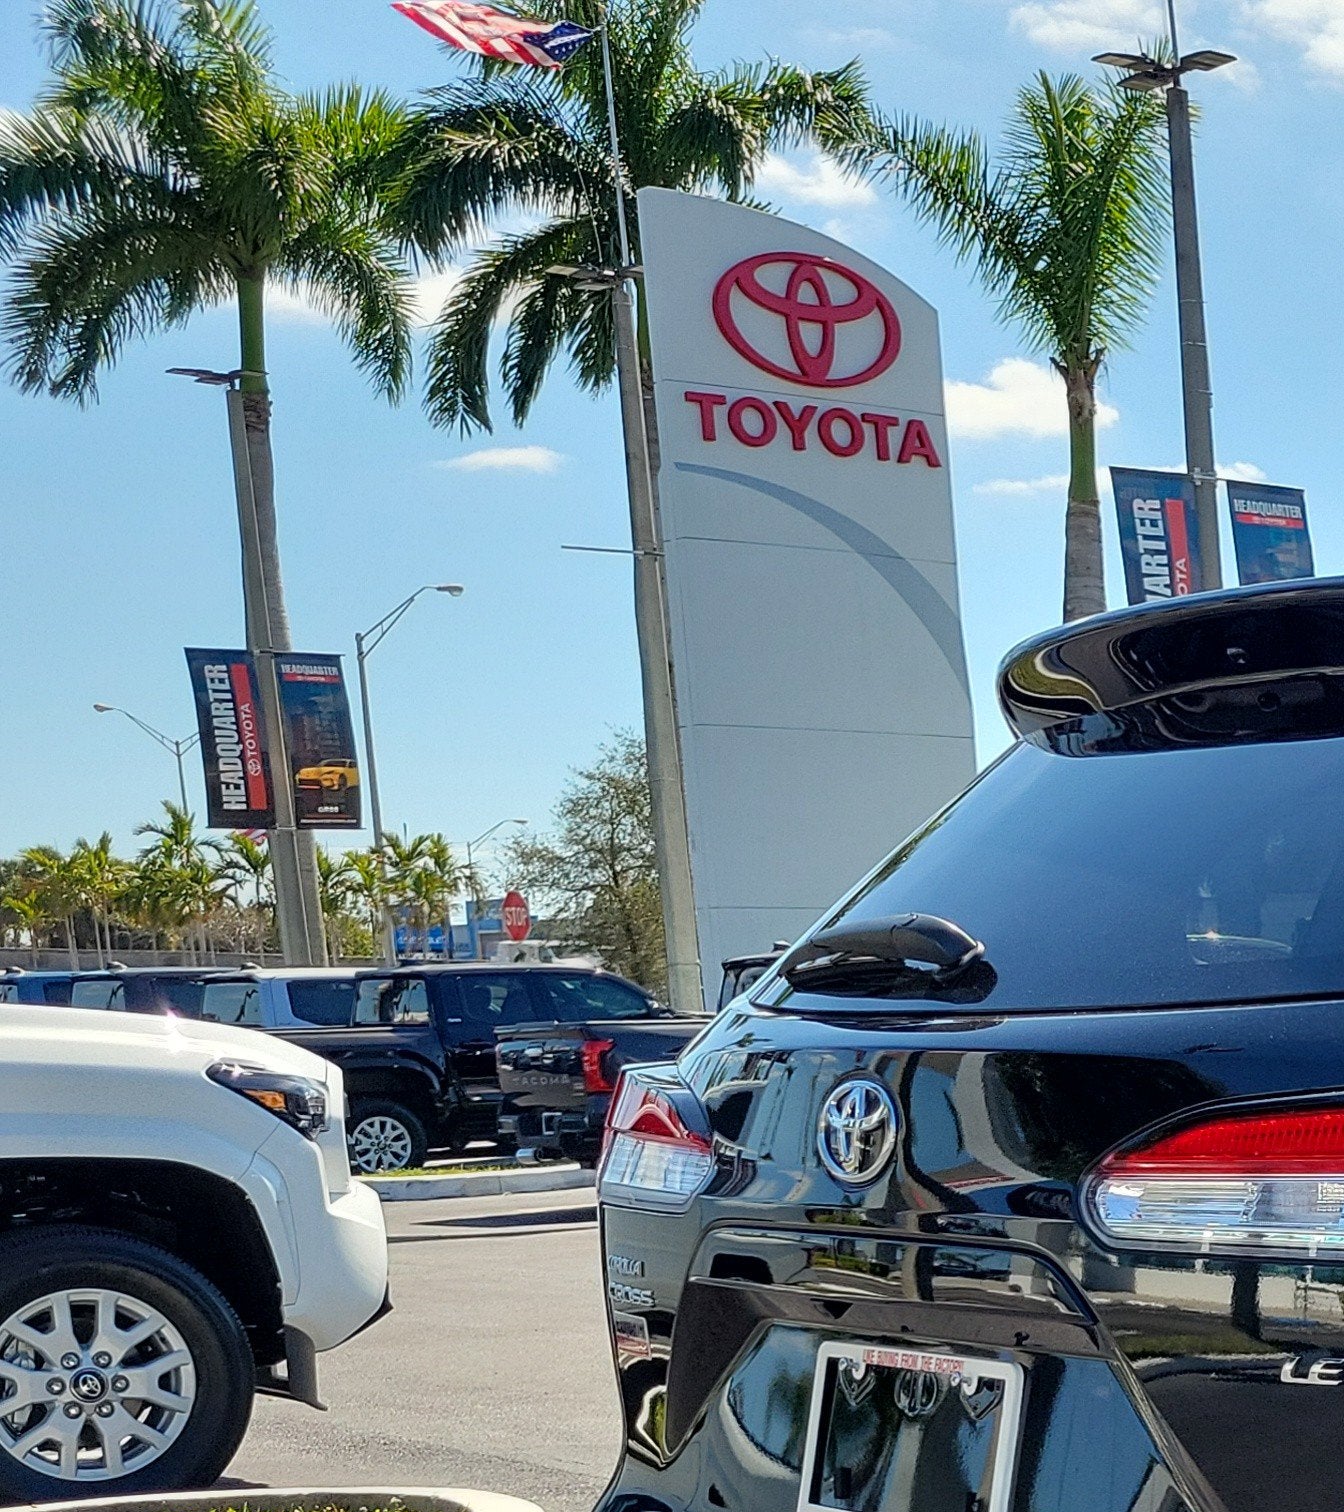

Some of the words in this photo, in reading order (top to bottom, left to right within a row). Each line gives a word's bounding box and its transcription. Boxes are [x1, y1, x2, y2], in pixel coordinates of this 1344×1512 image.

[684, 391, 942, 468] TOYOTA
[1233, 498, 1303, 519] HEADQUARTER
[1132, 499, 1173, 601] ARTER
[1175, 558, 1188, 595] OTA
[280, 663, 339, 675] HEADQUARTER
[204, 664, 248, 811] HEADQUARTER
[238, 703, 257, 759] TOYOTA
[504, 906, 528, 926] STOP
[512, 1073, 571, 1085] TACOMA
